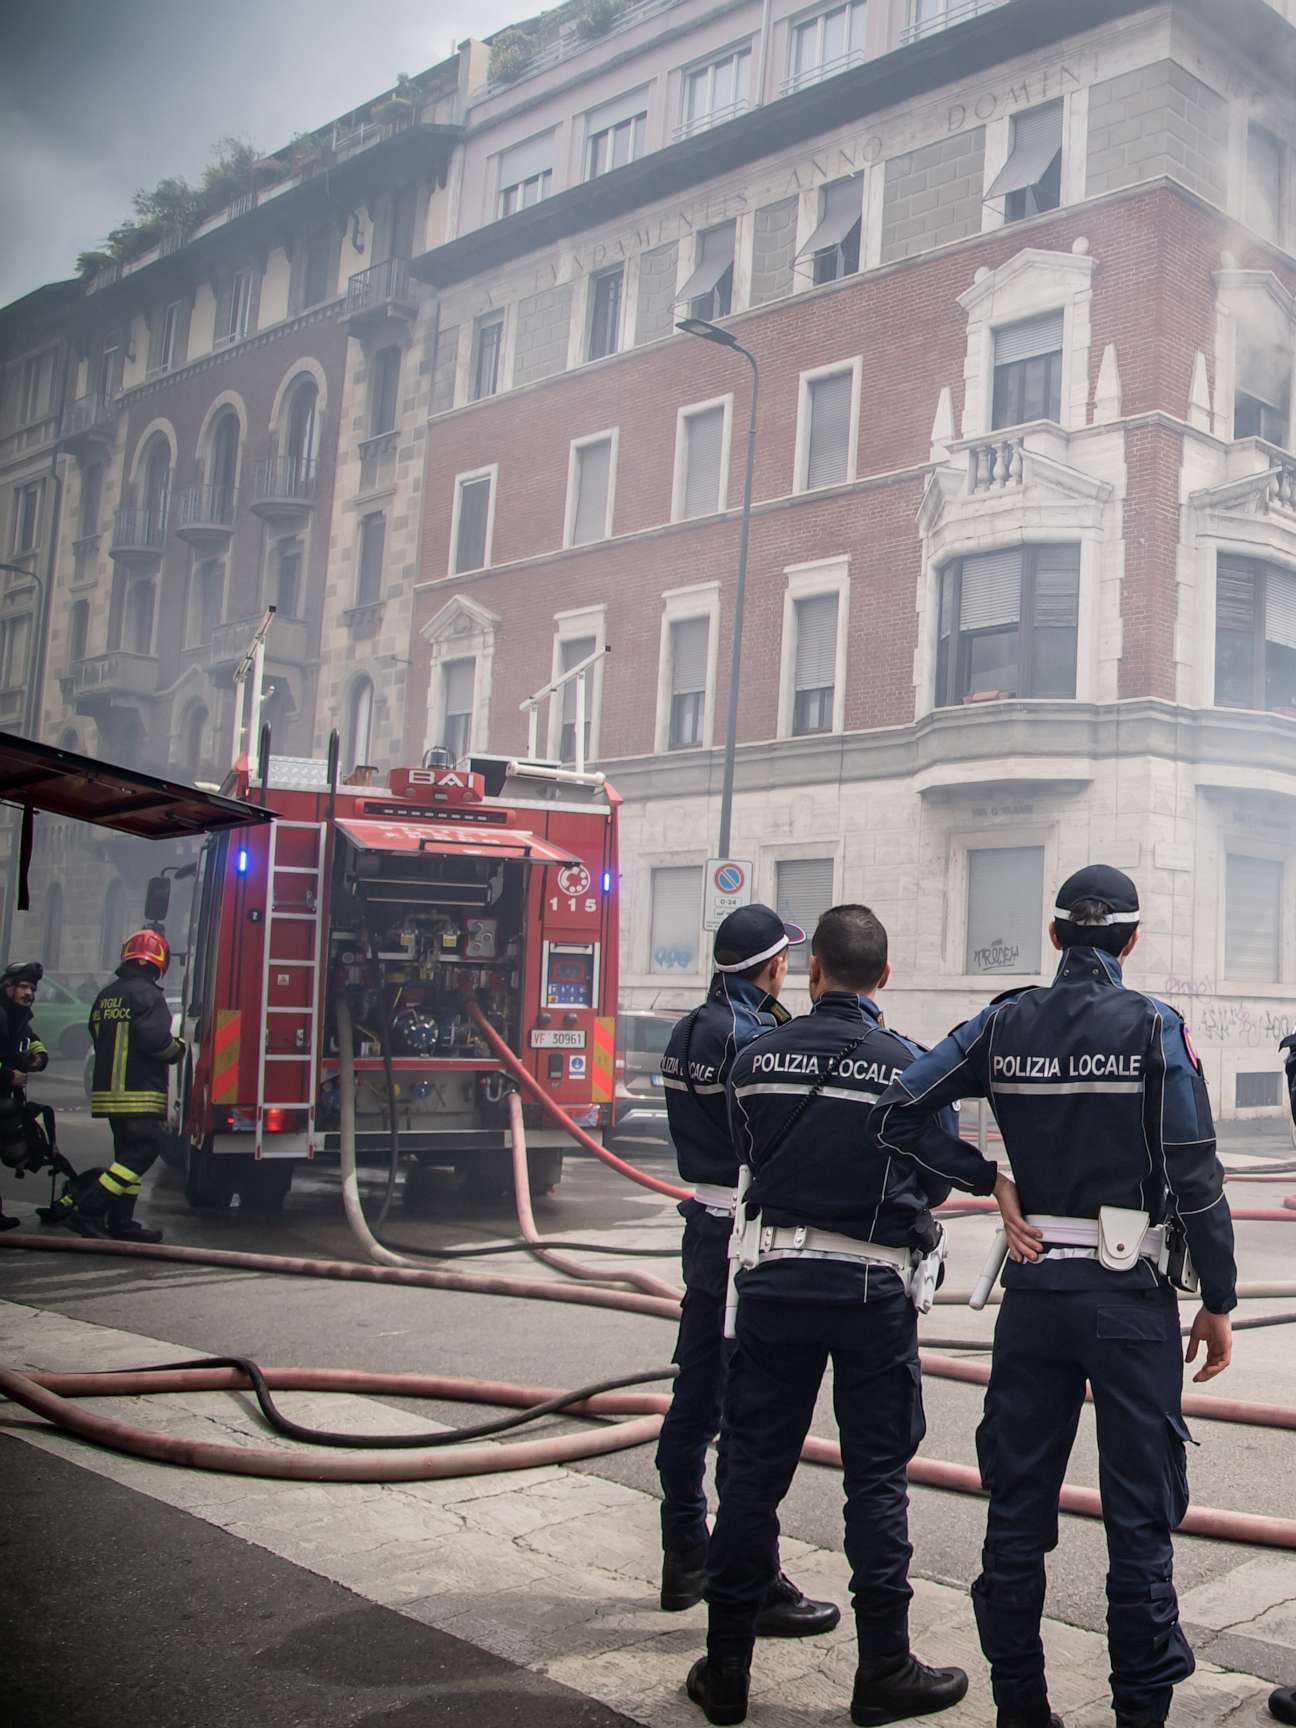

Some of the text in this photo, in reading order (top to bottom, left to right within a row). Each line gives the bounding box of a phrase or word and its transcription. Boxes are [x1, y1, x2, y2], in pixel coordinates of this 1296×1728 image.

[784, 135, 884, 194] ANNO
[946, 50, 1100, 132] DOMINI
[408, 769, 474, 788] BAI
[752, 1053, 819, 1074] POLIZIA
[993, 1054, 1142, 1078] POLIZIA LOCALE
